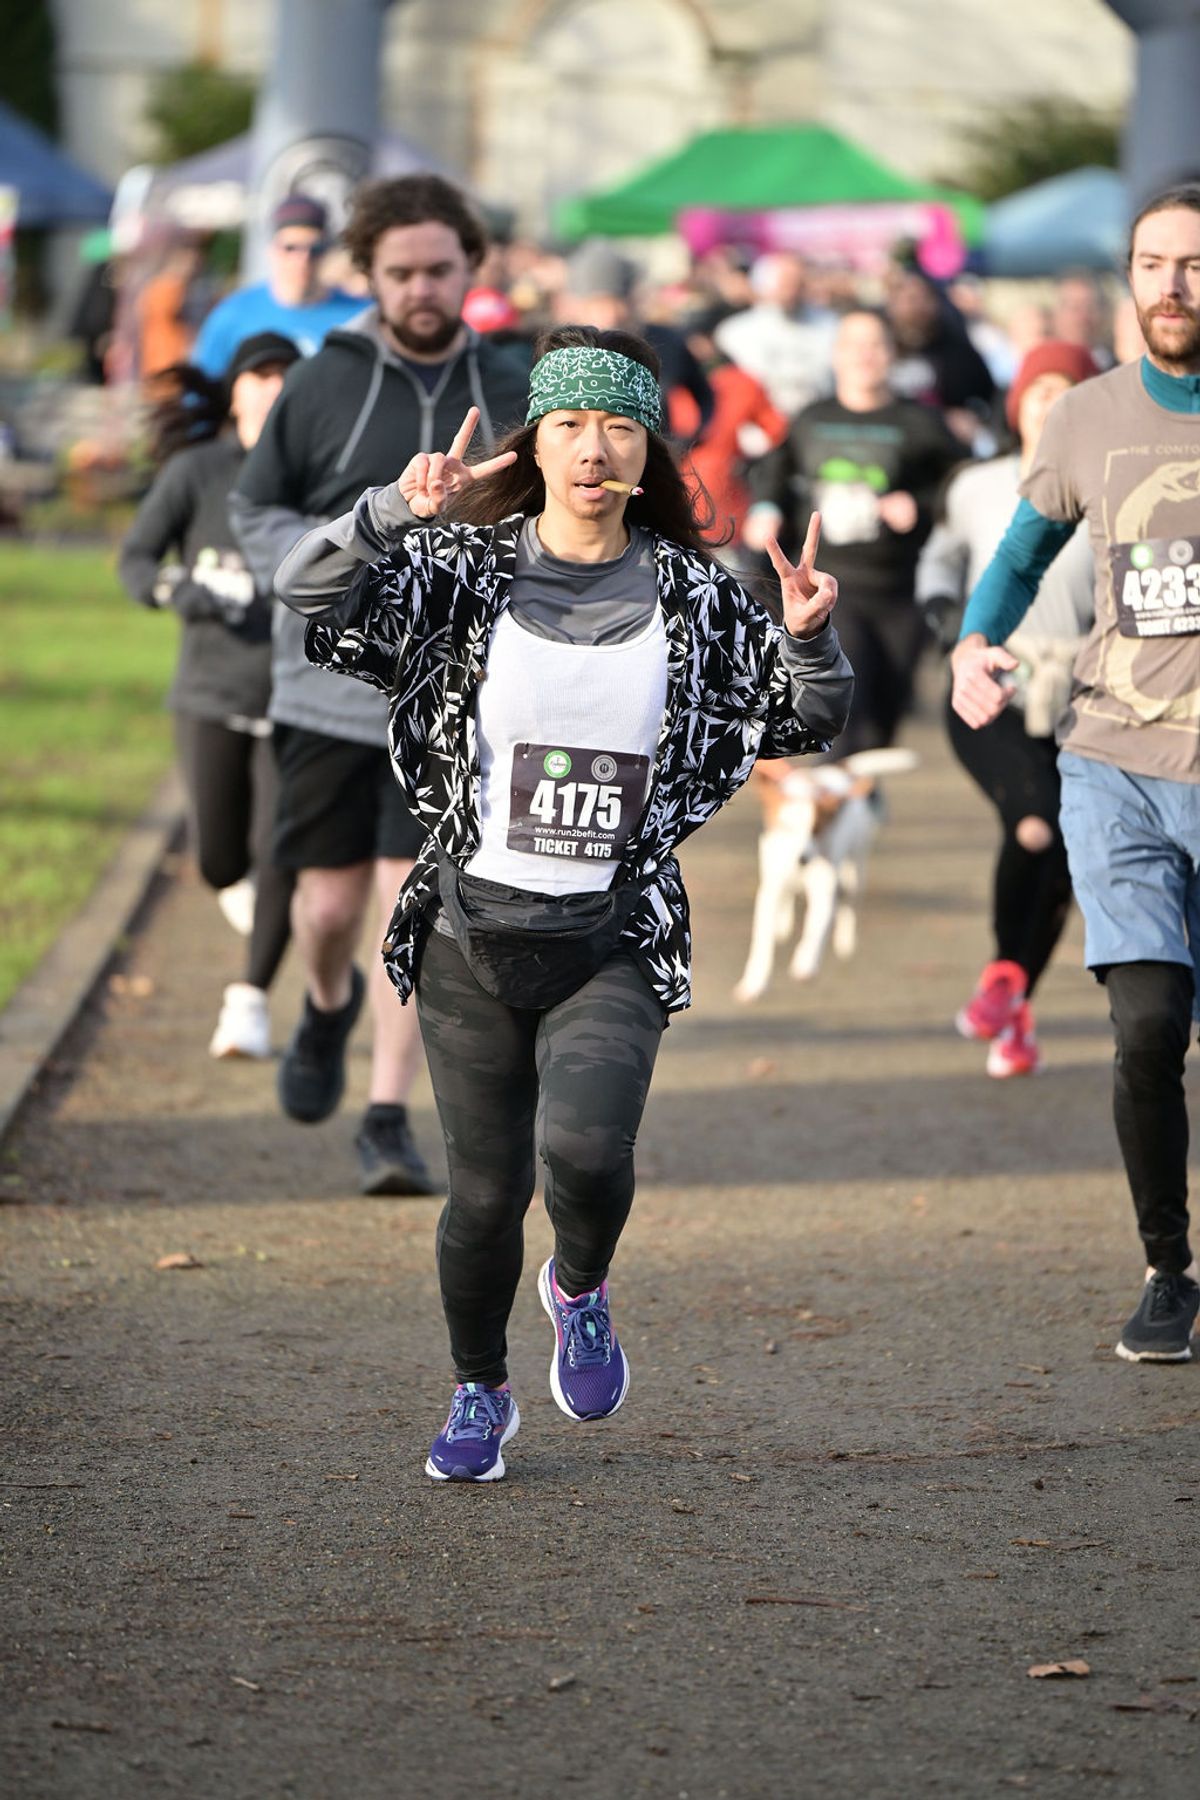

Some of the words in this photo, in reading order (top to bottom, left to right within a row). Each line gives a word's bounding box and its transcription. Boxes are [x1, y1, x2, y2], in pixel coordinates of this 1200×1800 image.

[1122, 563, 1200, 611] 4233
[529, 779, 623, 830] 4175
[533, 837, 579, 857] TICKET
[584, 842, 612, 858] 4175
[534, 826, 616, 840] www.run2befit.com
